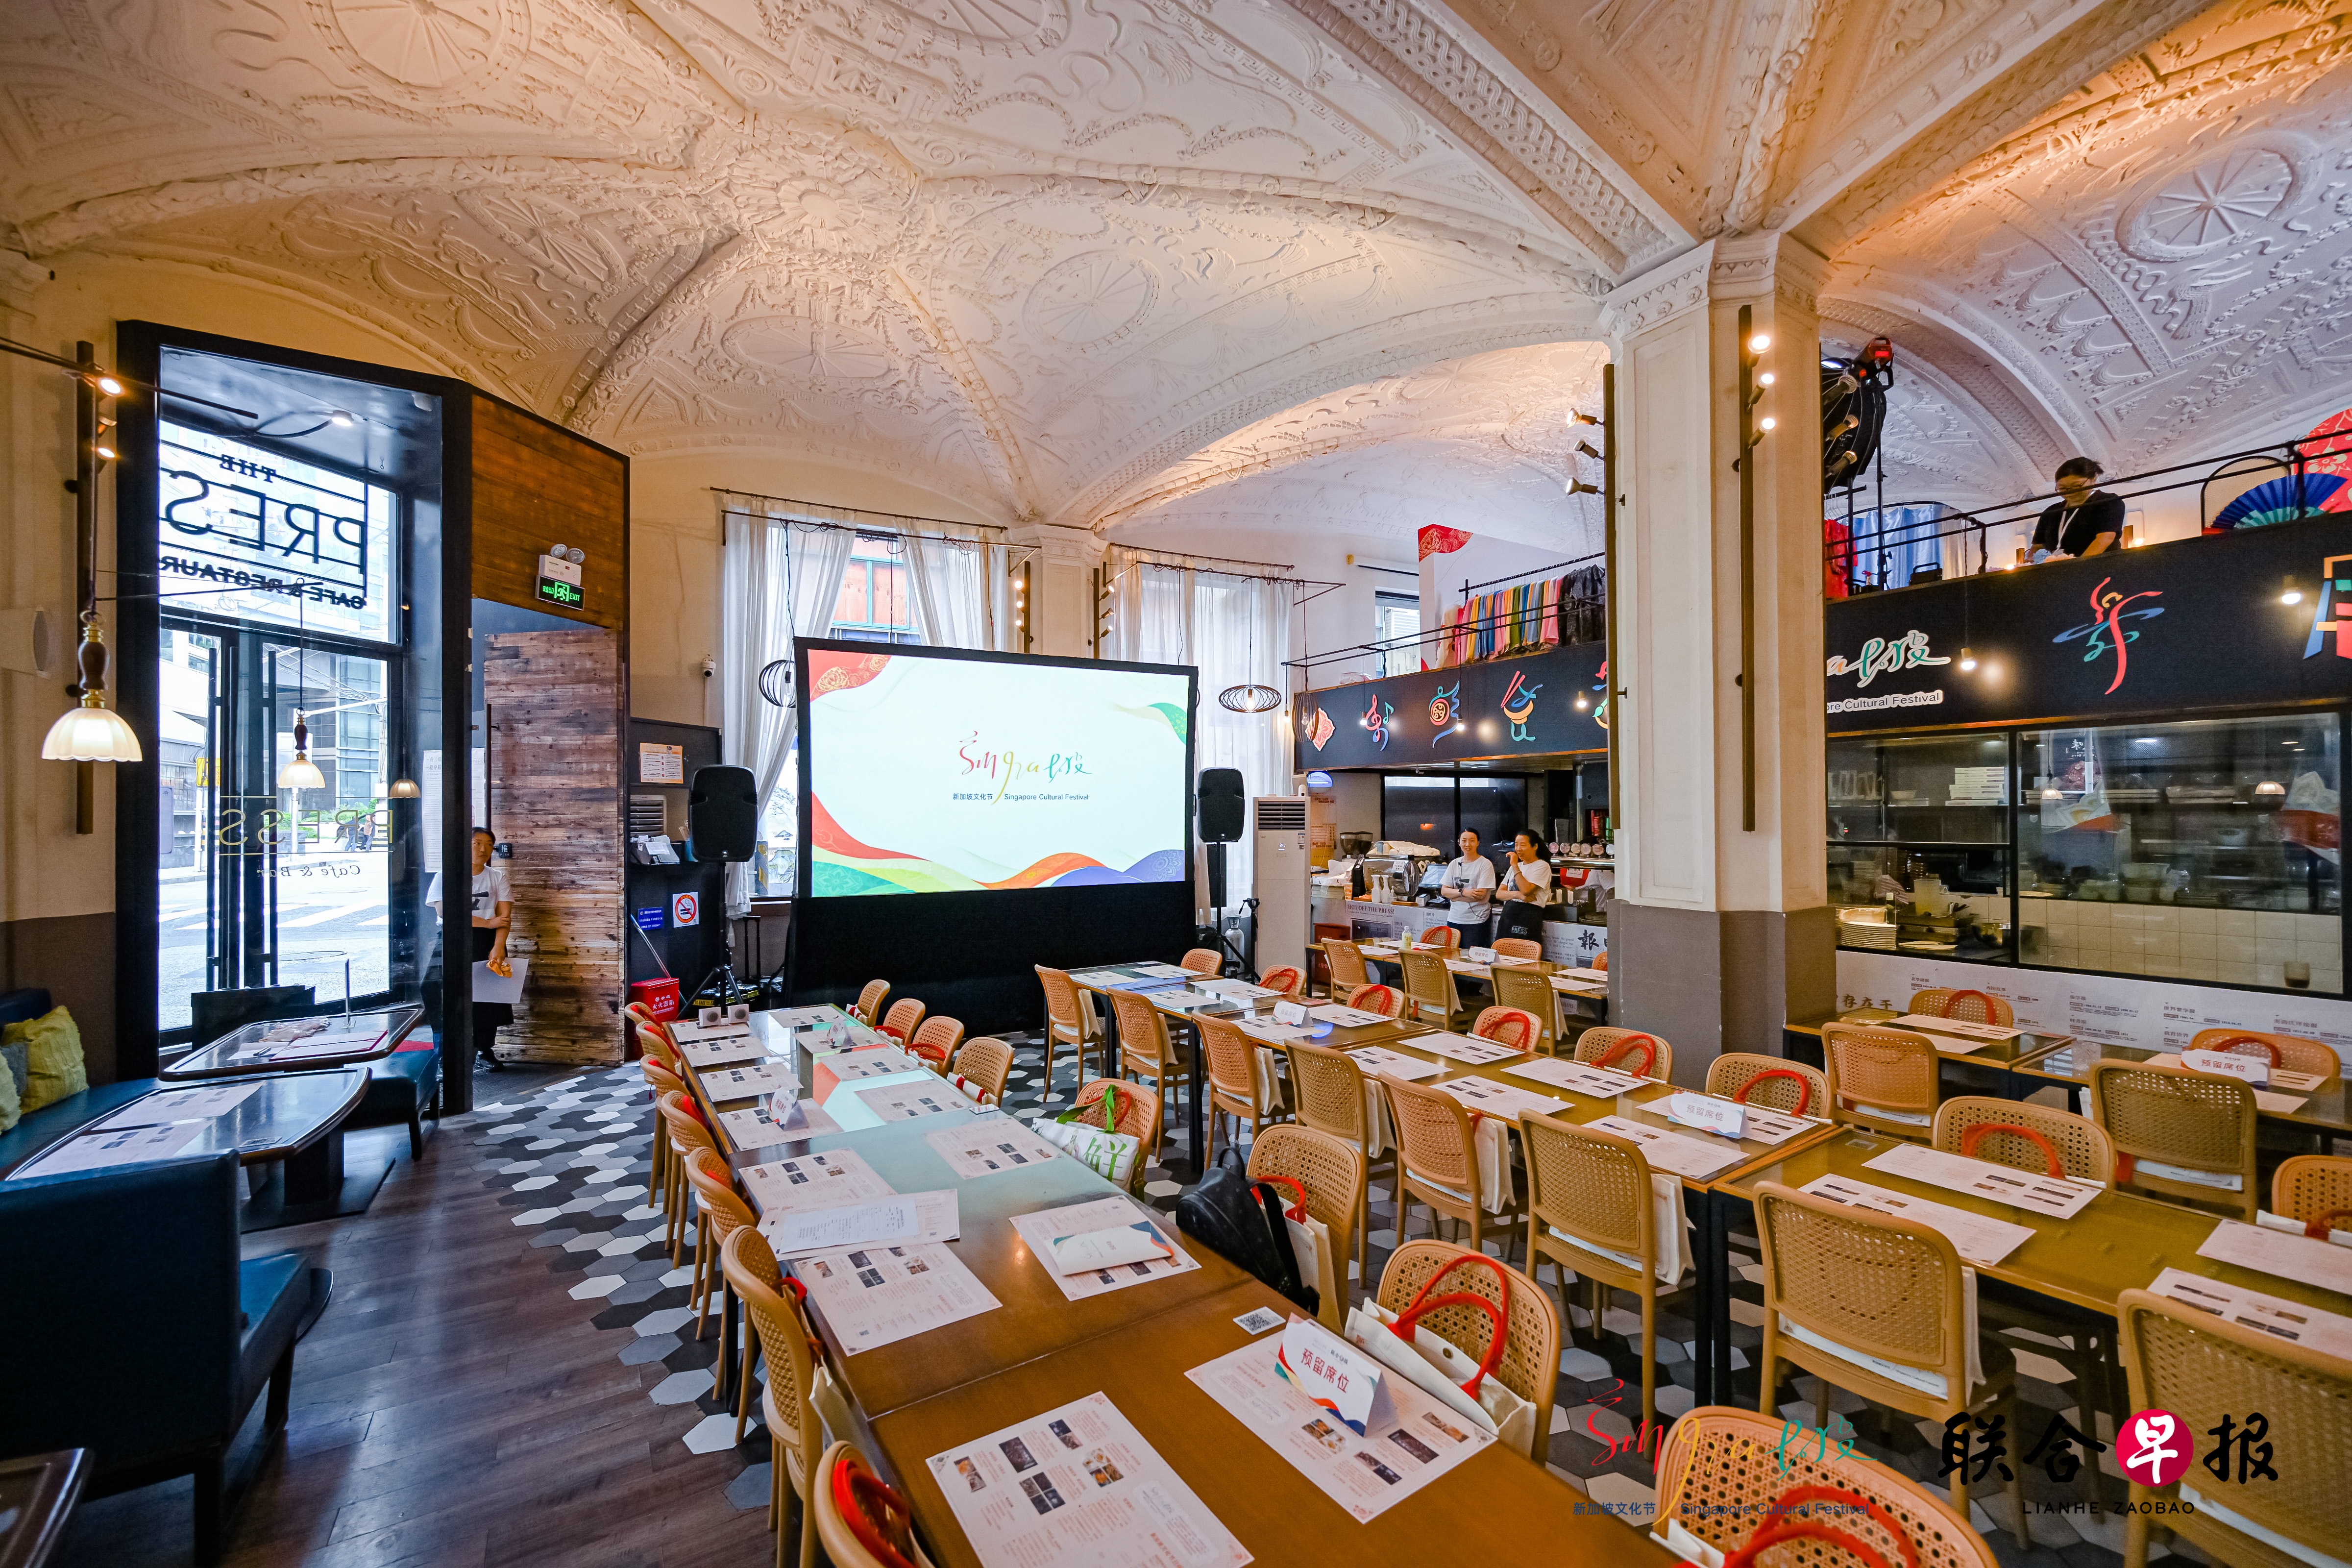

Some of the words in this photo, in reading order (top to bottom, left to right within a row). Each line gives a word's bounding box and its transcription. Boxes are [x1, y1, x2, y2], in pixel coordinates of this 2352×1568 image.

[570, 592, 580, 601] EXIT
[1845, 697, 1887, 709] Cultural
[1892, 692, 1939, 705] Festival
[652, 999, 674, 1010] 灭火器箱
[2202, 1059, 2246, 1072] 预留席位
[1686, 1104, 1725, 1122] 预留席位
[1082, 1137, 1127, 1182] 鲜
[1301, 1348, 1349, 1394] 预留席位
